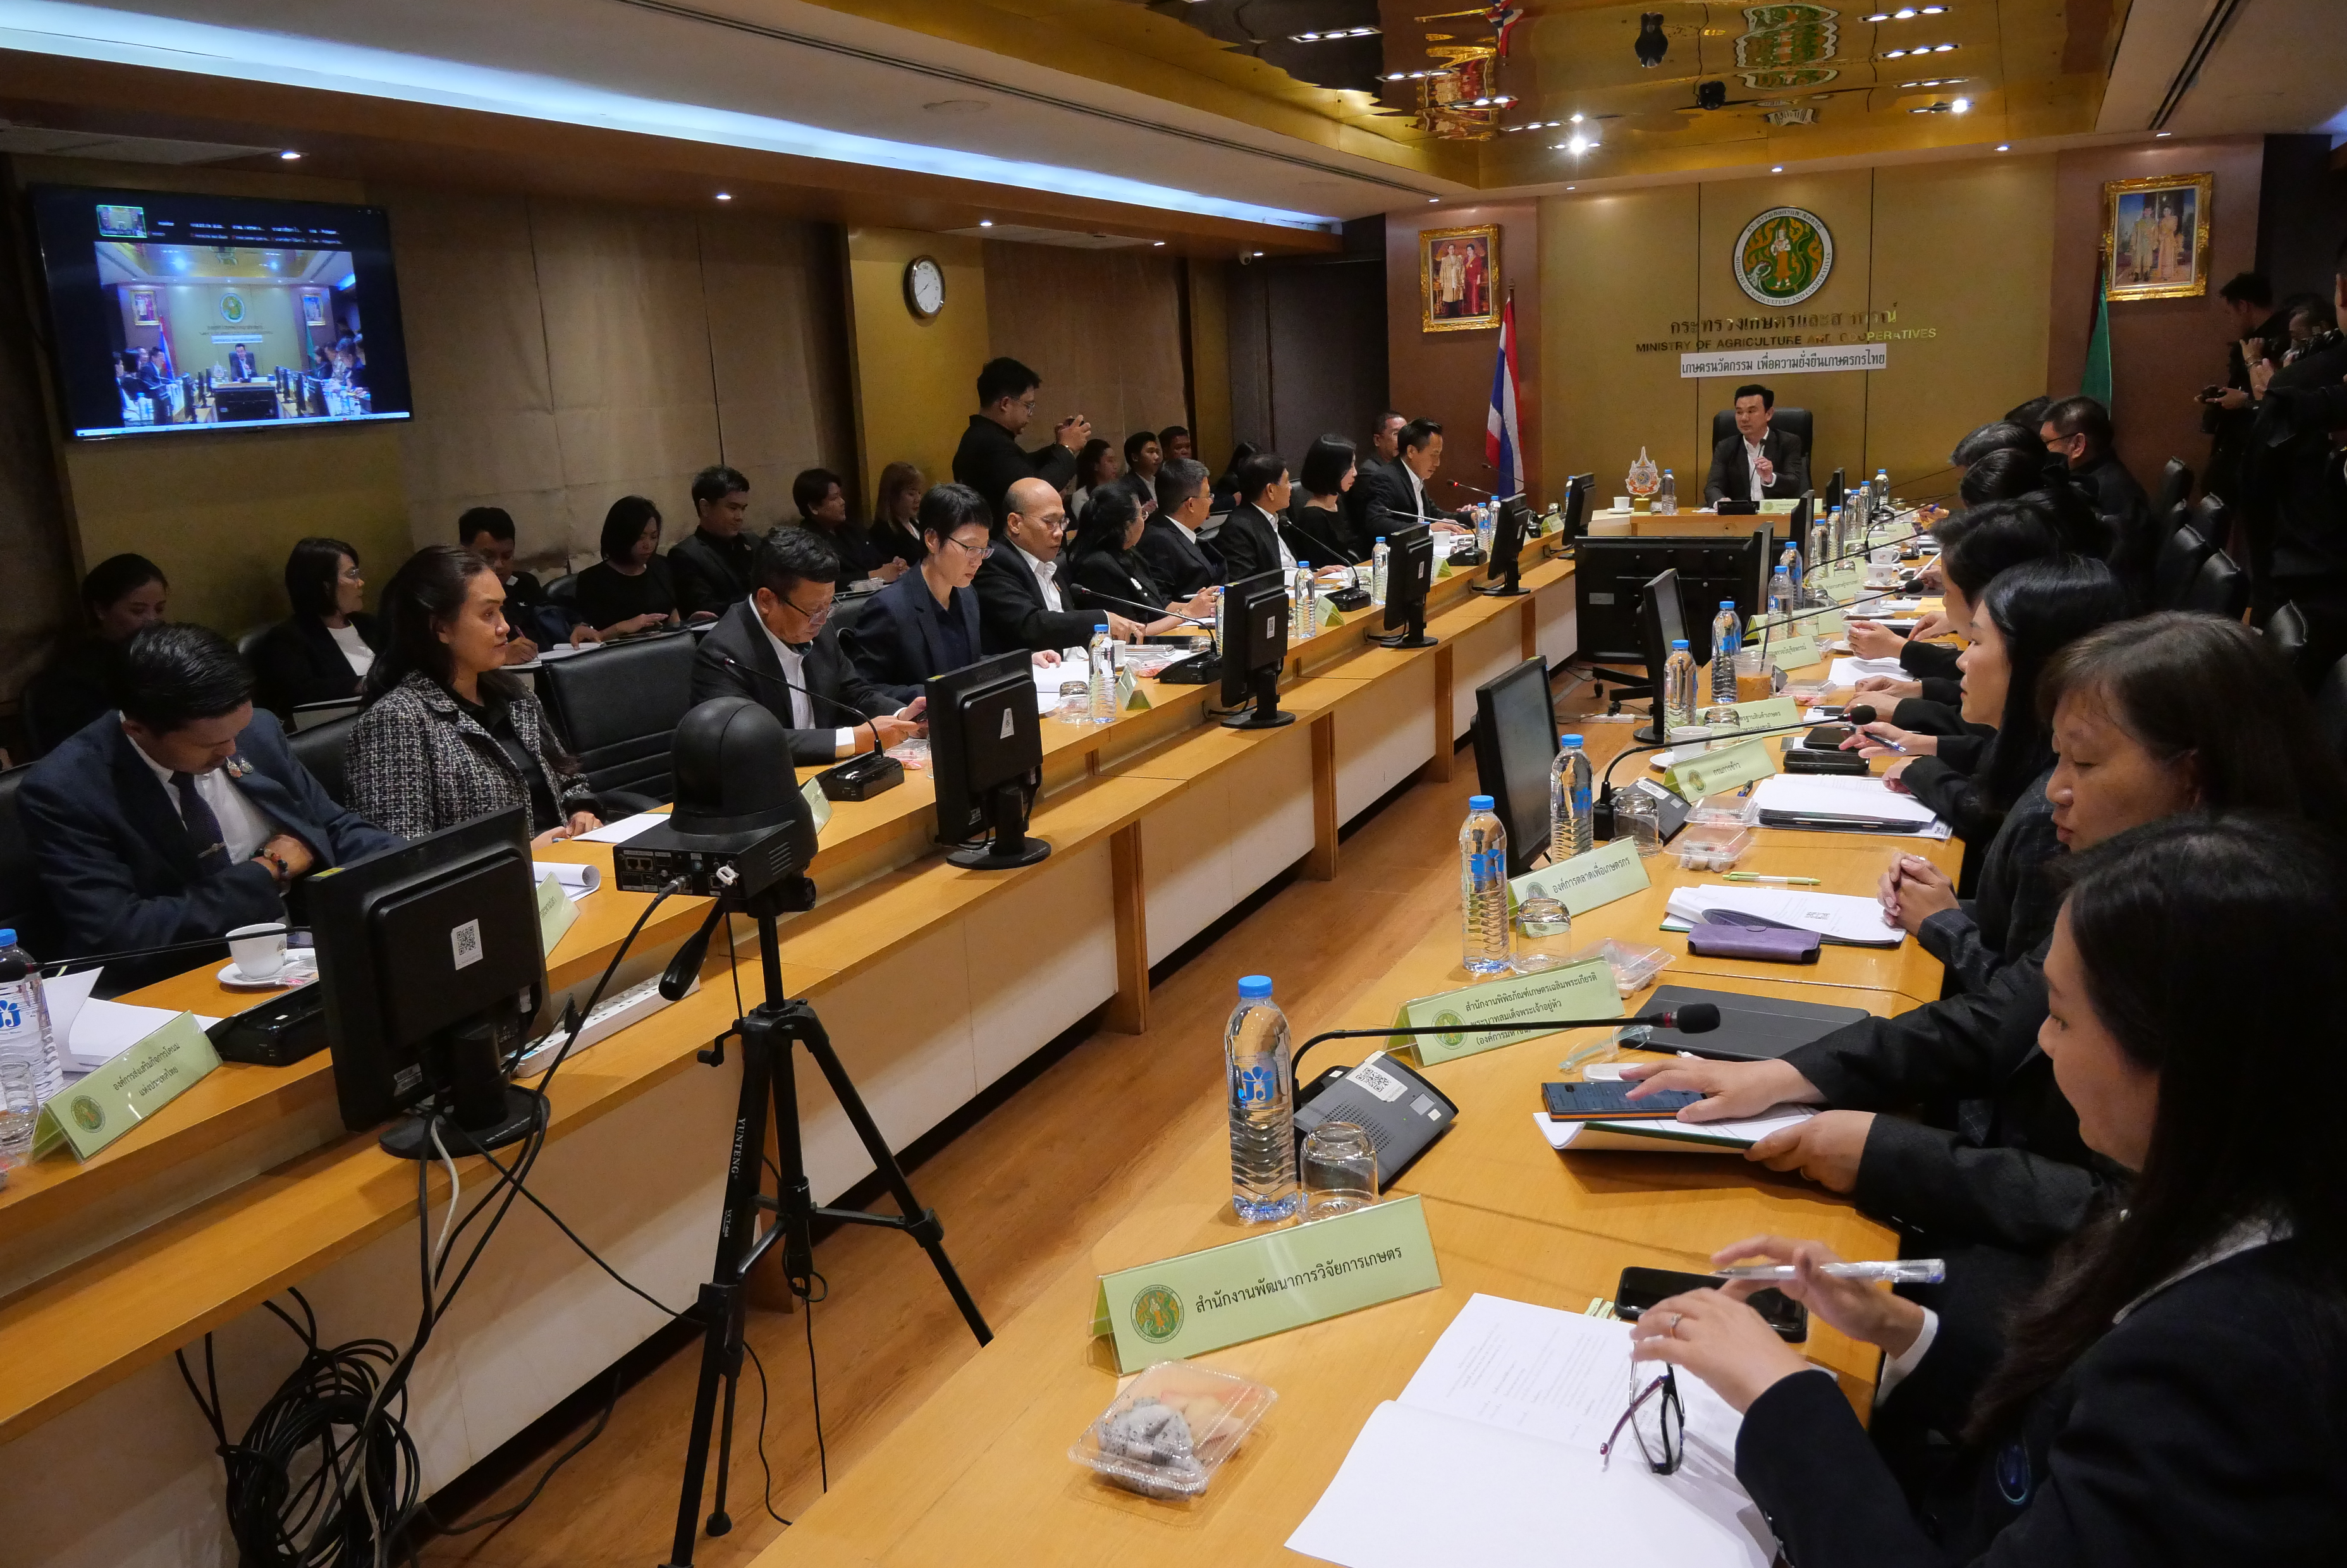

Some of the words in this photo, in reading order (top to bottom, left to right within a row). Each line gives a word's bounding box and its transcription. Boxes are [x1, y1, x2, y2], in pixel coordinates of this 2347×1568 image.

[1736, 256, 1745, 282] MINISTRY
[1744, 283, 1751, 292] OF
[1751, 291, 1791, 305] AGRICULTURE
[1792, 293, 1805, 302] AND
[1805, 252, 1830, 295] COOPERATIVES
[1636, 340, 1691, 353] MINISTRY
[1696, 339, 1712, 350] OF
[1716, 335, 1802, 350] AGRICULTURE
[1681, 357, 1753, 374] เกษตรนวัตกรรม
[1756, 348, 1885, 370] เพื่อความยั่งยืนเกษตรกรไทย
[1713, 761, 1741, 776] กรมการข้าว
[1552, 857, 1631, 893] องค์การตลาดเพื่อเกษตรกร
[1465, 972, 1597, 1012] สำนักงานพิพิธภัณฑ์เกษตรเฉลิมพระเกียรติ
[113, 1043, 181, 1091] องค์การส่งเสริมกิจการโคนม
[138, 1066, 179, 1097] แห่งประเทศไทย
[731, 1117, 746, 1174] YUNTENG
[1195, 1246, 1402, 1313] สำนักงานพัฒนาการวิจัยการเกษตร
